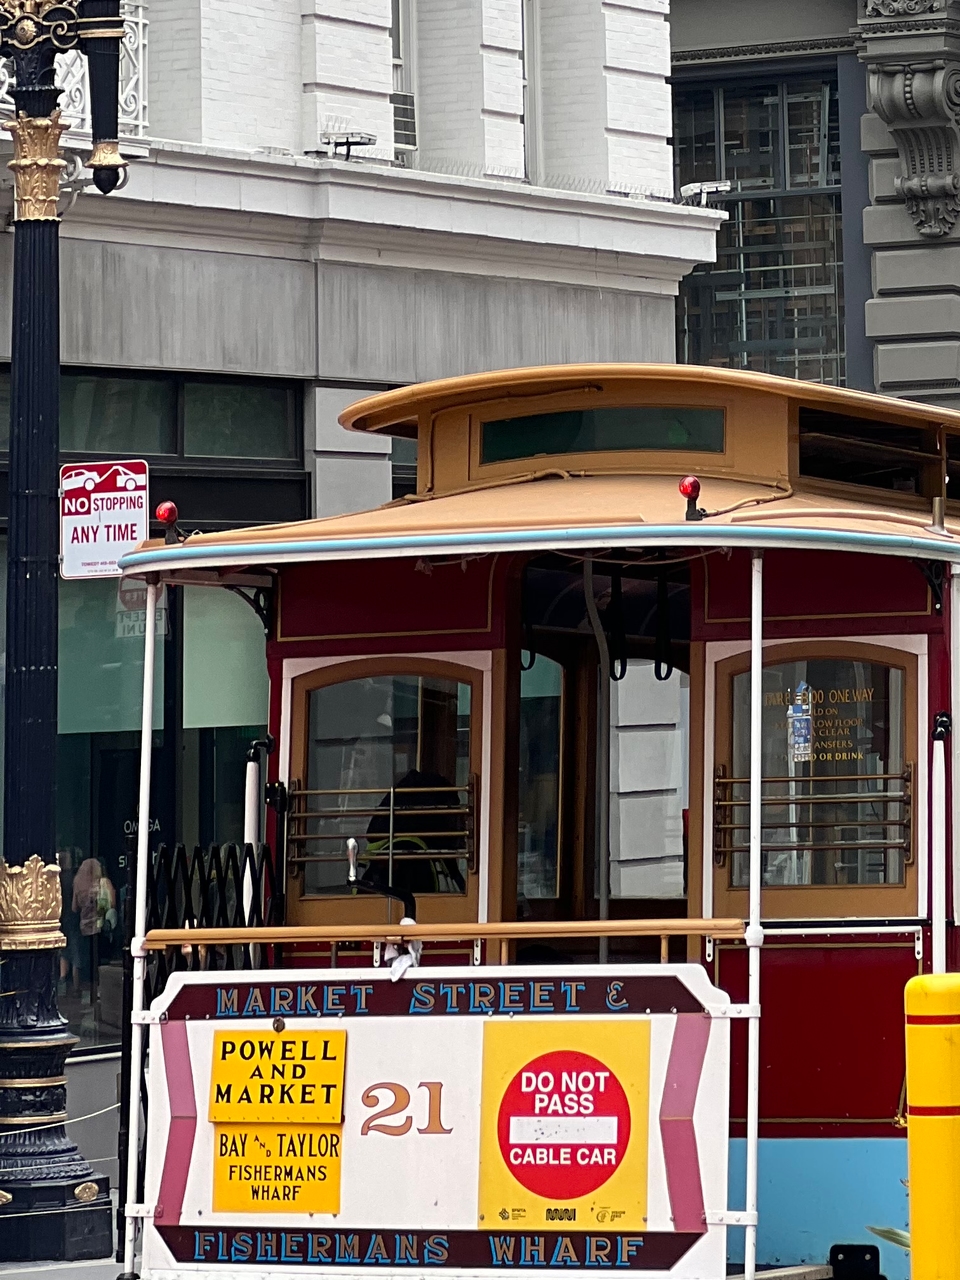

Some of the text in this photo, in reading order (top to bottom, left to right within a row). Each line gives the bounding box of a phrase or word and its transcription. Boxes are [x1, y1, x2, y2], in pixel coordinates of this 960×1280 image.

[64, 495, 144, 514] NO STOPPING
[71, 523, 138, 544] ANY TIME
[828, 689, 851, 704] ONE
[852, 688, 875, 703] WAY
[819, 728, 851, 737] CLEAR
[814, 740, 853, 749] ANSFERS
[819, 752, 832, 761] OR
[835, 752, 864, 761] DRINK
[216, 980, 629, 1017] MARKET STREET &
[220, 1039, 337, 1061] POWELL
[249, 1063, 306, 1080] AND
[521, 1071, 610, 1093] DO NOT
[215, 1083, 338, 1104] MARKET
[360, 1081, 454, 1137] 21
[534, 1093, 595, 1115] PASS
[220, 1133, 340, 1158] BAY AND TAYLOR
[509, 1147, 617, 1166] CABLE CAR
[228, 1164, 328, 1182] FISHERMANS
[251, 1184, 302, 1201] WHARF
[193, 1230, 645, 1267] FISHERMANS WHARF
